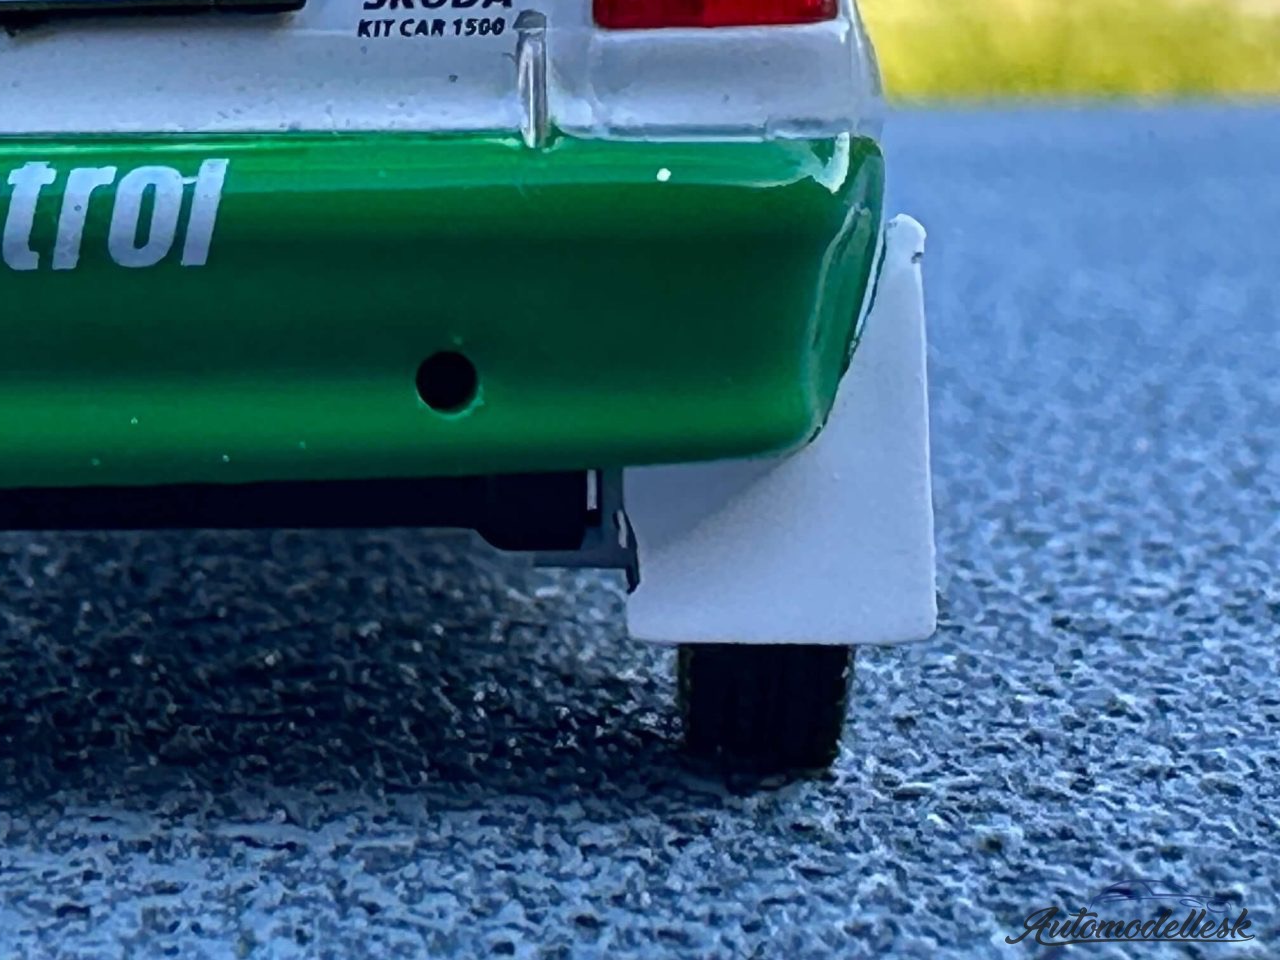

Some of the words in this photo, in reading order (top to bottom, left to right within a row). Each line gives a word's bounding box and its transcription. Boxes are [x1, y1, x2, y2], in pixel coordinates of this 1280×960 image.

[357, 19, 395, 38] KIT
[399, 18, 446, 37] CAR
[452, 16, 506, 36] 1500
